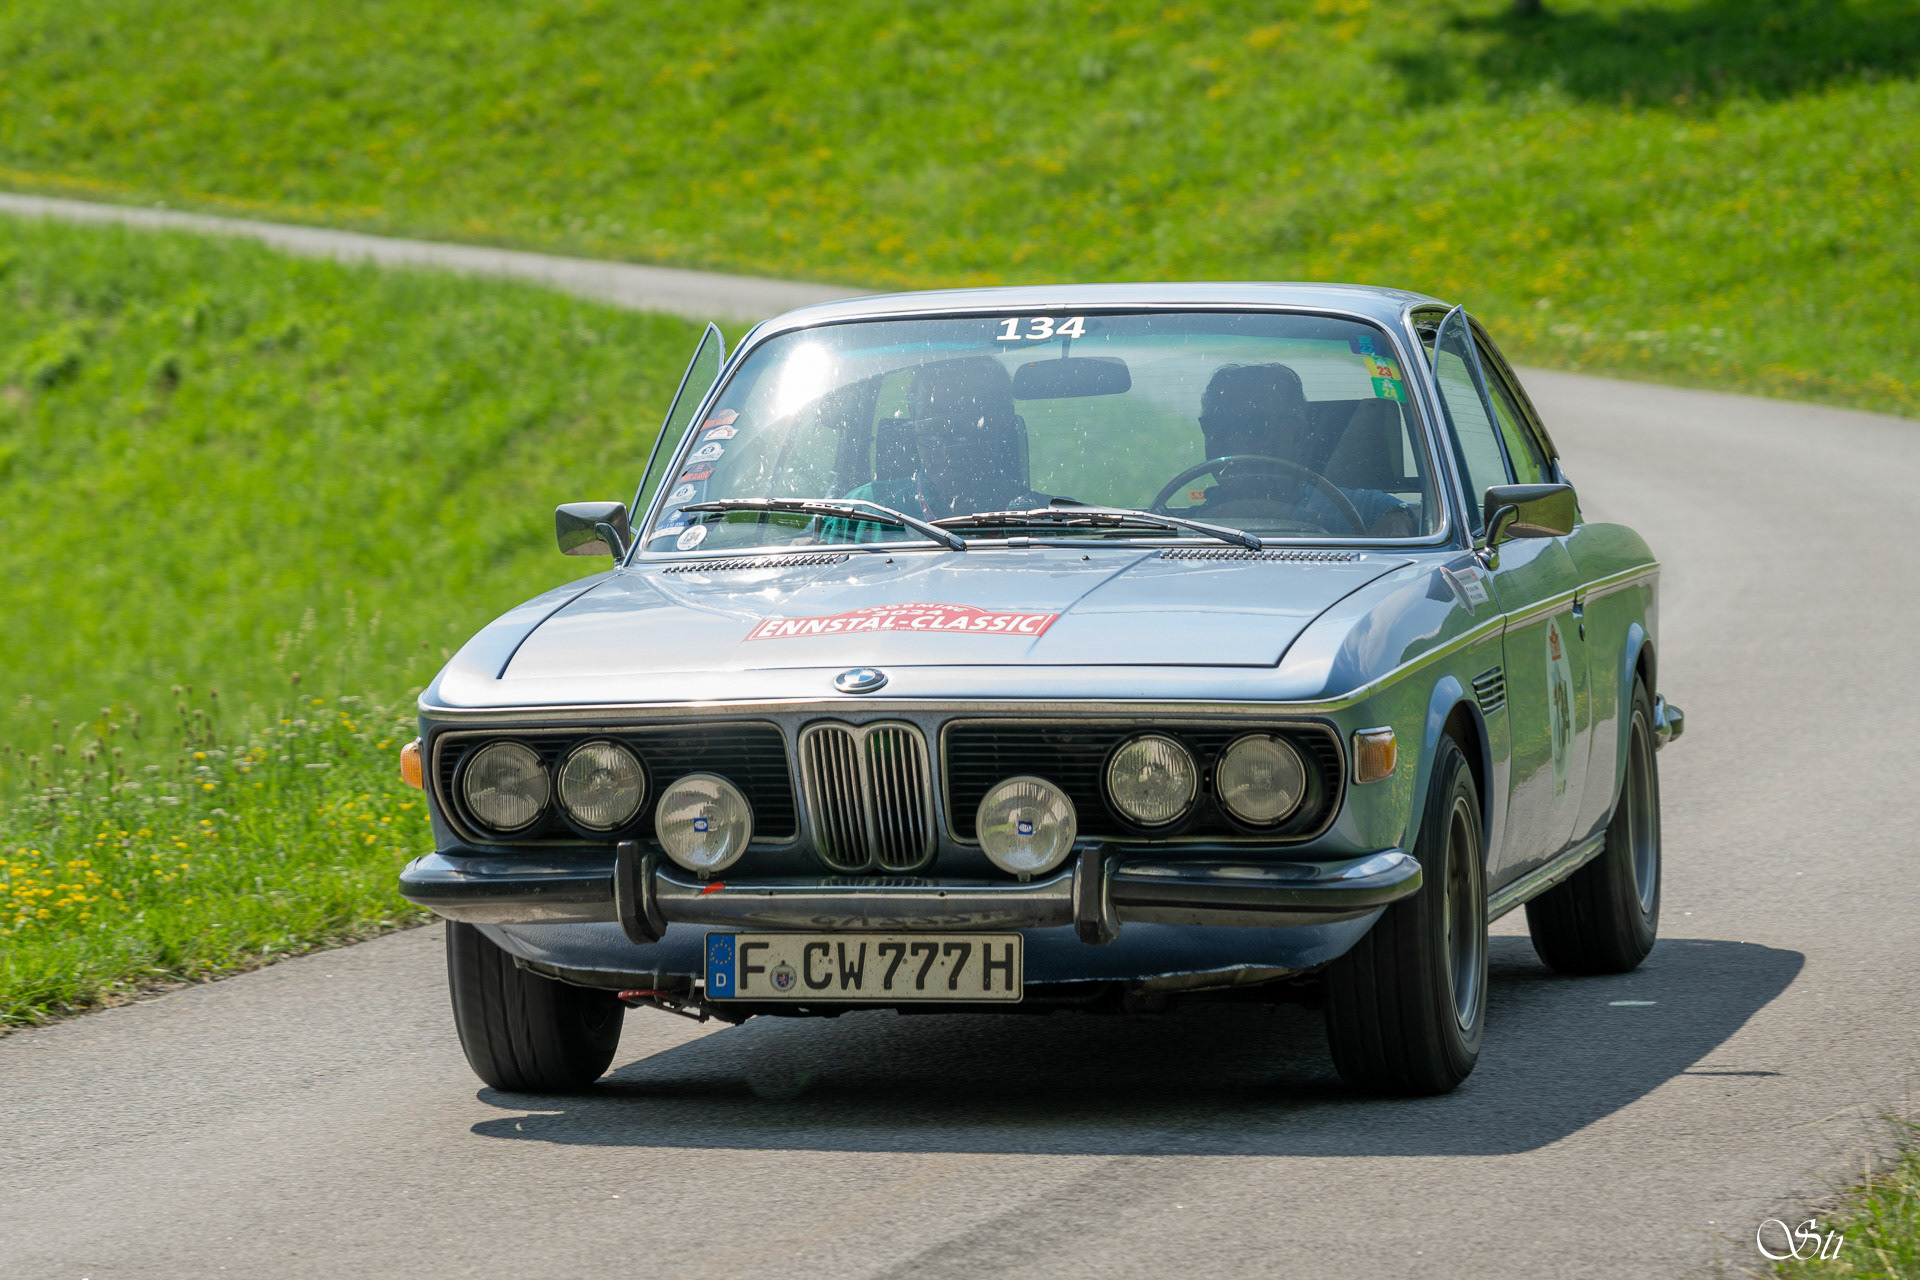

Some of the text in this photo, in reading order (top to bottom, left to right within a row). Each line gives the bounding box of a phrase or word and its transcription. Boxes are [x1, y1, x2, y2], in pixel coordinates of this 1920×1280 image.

[996, 316, 1086, 341] 134
[1376, 366, 1393, 378] 23
[874, 609, 944, 617] 2024
[757, 615, 1045, 638] ENNSTAL-CLASSIC
[739, 942, 770, 990] F
[715, 973, 727, 987] D
